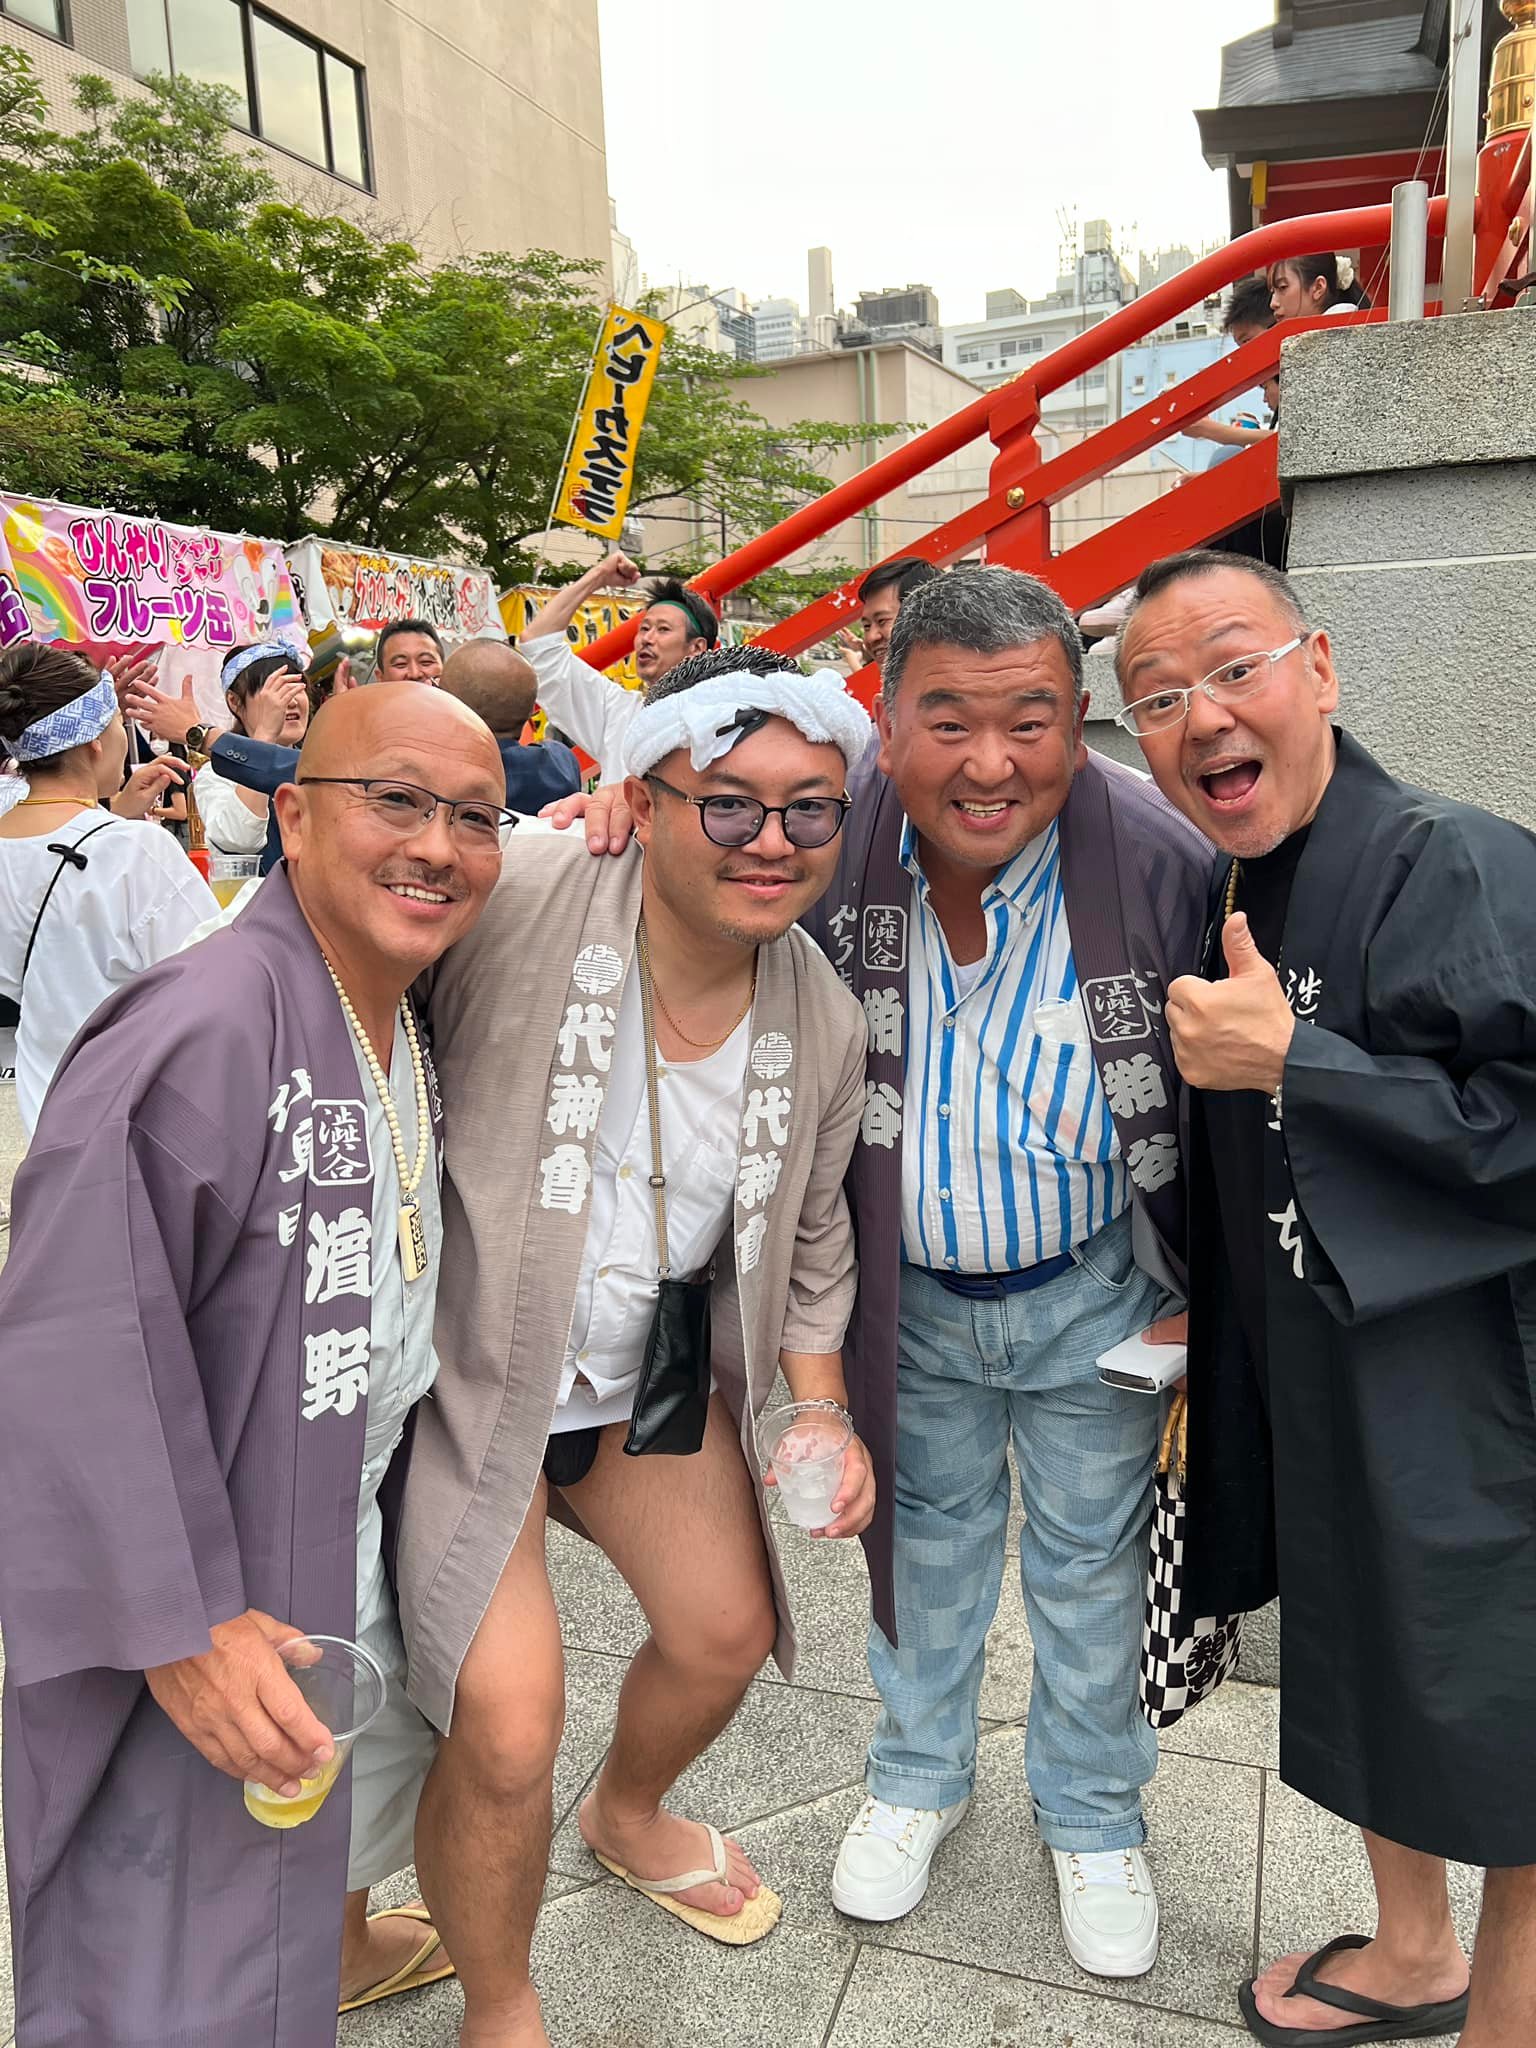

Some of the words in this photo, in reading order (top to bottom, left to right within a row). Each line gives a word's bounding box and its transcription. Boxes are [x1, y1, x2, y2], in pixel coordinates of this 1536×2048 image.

[68, 516, 171, 582] ひんやり
[169, 535, 222, 560] シャリ
[174, 557, 224, 585] シャリ
[84, 577, 236, 646] フルーツ缶
